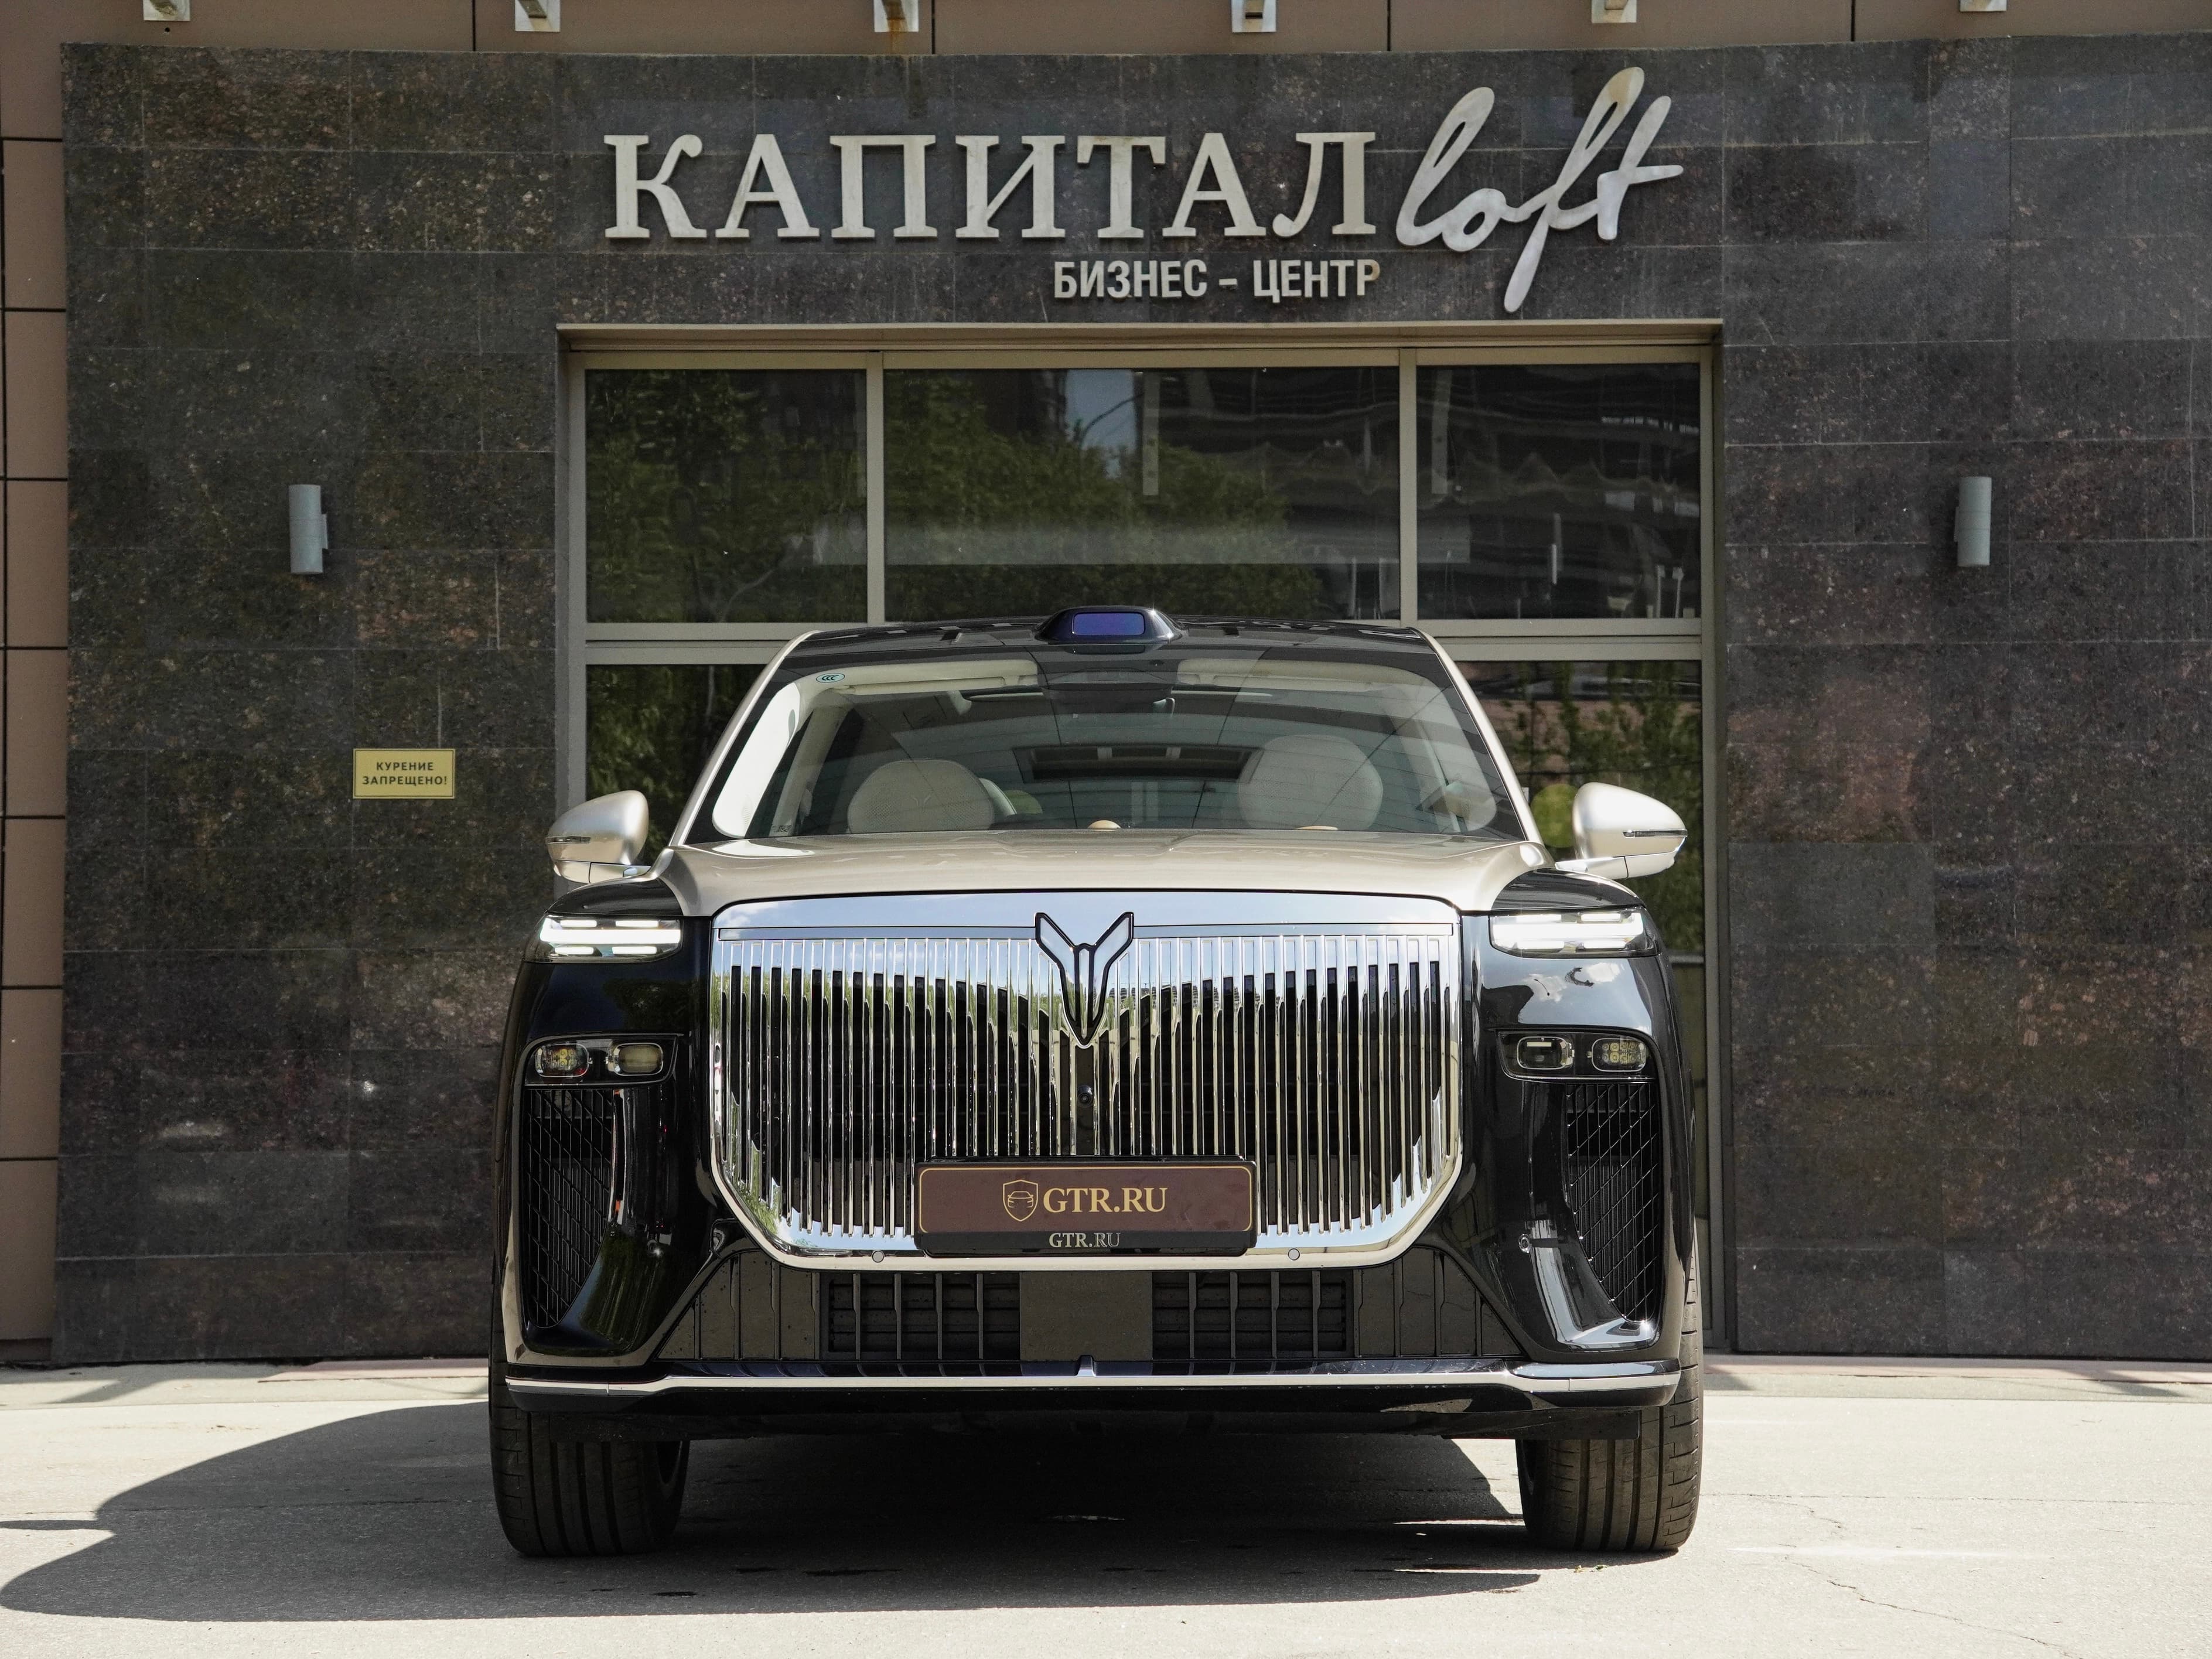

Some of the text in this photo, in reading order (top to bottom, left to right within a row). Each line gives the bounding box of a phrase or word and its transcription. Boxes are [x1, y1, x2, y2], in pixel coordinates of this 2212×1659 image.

[603, 66, 1684, 313] КАПИТАЛ loft
[1053, 259, 1208, 300] БИЗНЕС
[1253, 259, 1380, 303] ЦЕНТР
[376, 762, 434, 771] КУРЕНИЕ
[362, 776, 447, 786] ЗАПРЕЩЕНО!
[1043, 1187, 1168, 1213] GTR.RU
[1049, 1233, 1121, 1248] GTR.RU
